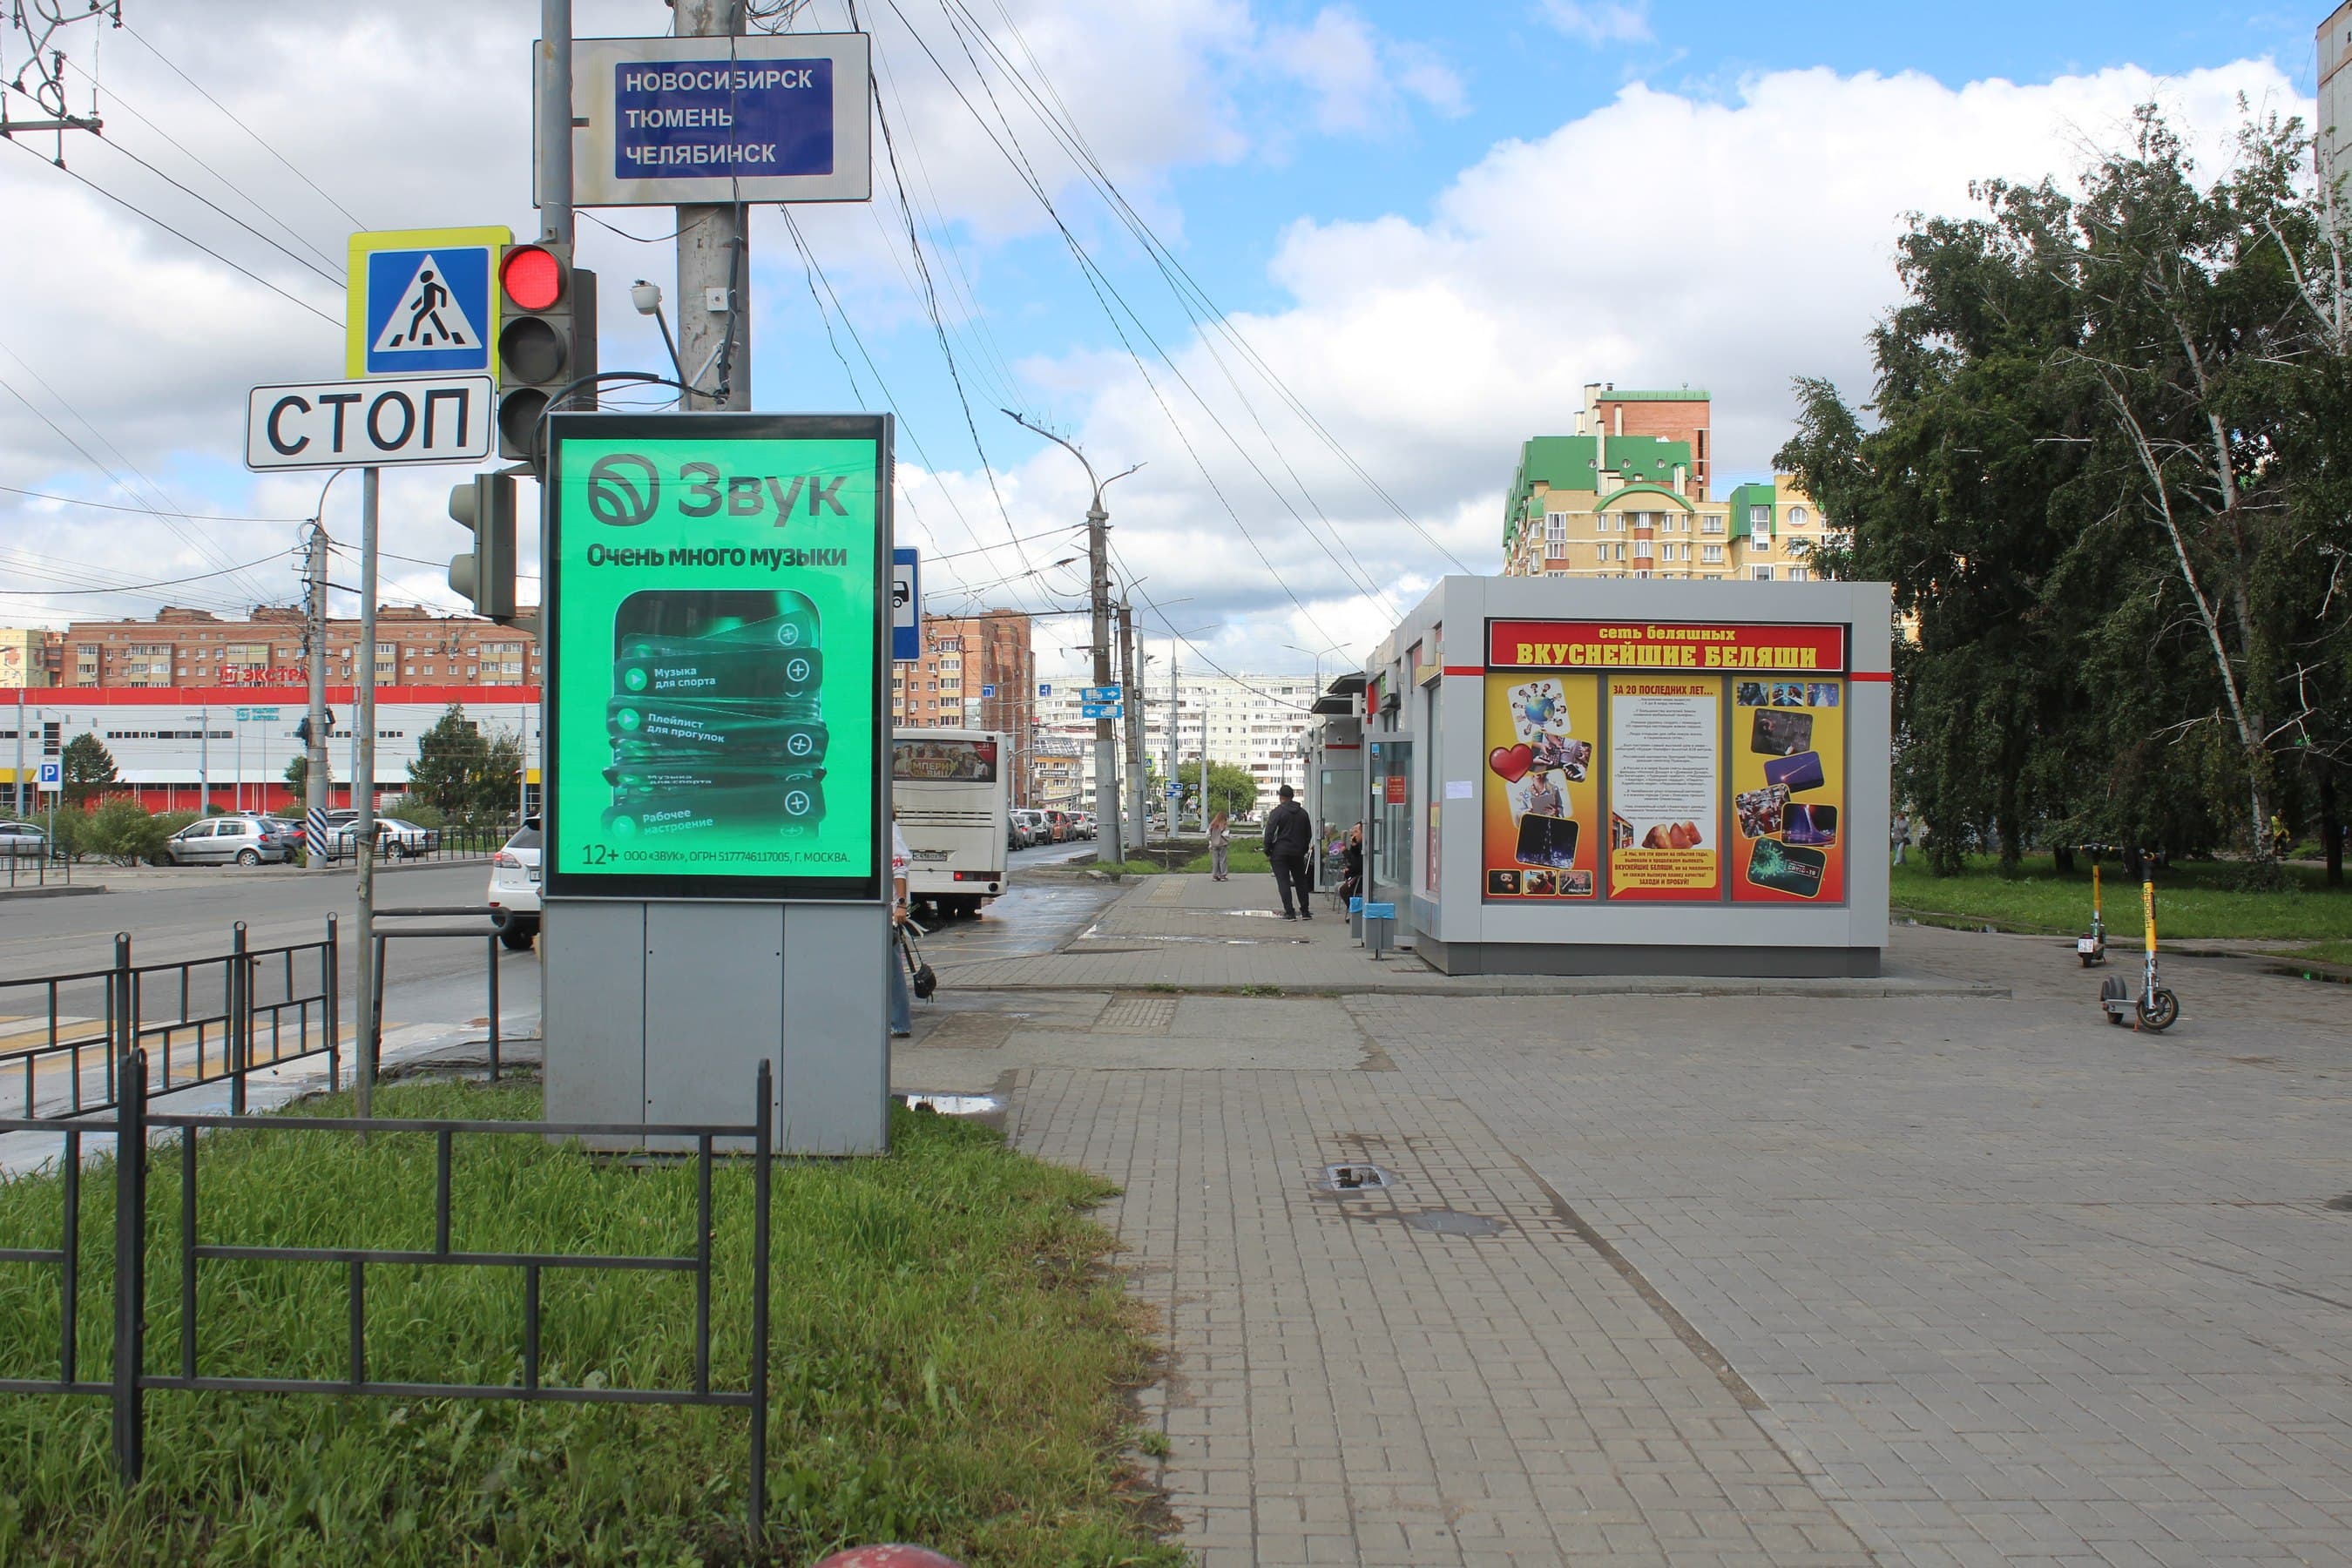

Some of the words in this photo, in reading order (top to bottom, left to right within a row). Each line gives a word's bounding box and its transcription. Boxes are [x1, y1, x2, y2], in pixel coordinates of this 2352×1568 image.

[626, 70, 812, 91] НОВОСИБИРСК
[625, 108, 733, 128] ТЮМЕНЬ
[626, 144, 776, 165] ЧЕЛЯБИНСК
[267, 388, 470, 456] СТОП
[679, 462, 849, 527] Звук
[587, 544, 664, 567] Очень
[669, 547, 746, 567] много
[750, 547, 848, 571] музыки
[1599, 628, 1642, 640] сеть
[1646, 625, 1735, 642] беляшных
[1517, 642, 1696, 667] ВКУСНЕЙШИЕ
[1704, 646, 1817, 668] БЕЛЯШИ
[243, 668, 309, 682] ЭКСТРА
[654, 667, 697, 679] Музыка
[655, 680, 675, 689] для
[678, 678, 717, 687] спорта
[1613, 685, 1624, 694] ЗА
[1626, 685, 1637, 694] 20
[1639, 685, 1686, 696] ПОСЛЕДНИХ
[648, 713, 704, 728] Плейлист
[647, 725, 668, 734] для
[671, 728, 725, 743] прогулок
[643, 809, 691, 822] Рабочее
[645, 818, 713, 835] настроение
[582, 844, 619, 865] 12+
[624, 850, 647, 862] ООО
[689, 851, 717, 862] ОГРН
[805, 852, 850, 862] МОСКВА.
